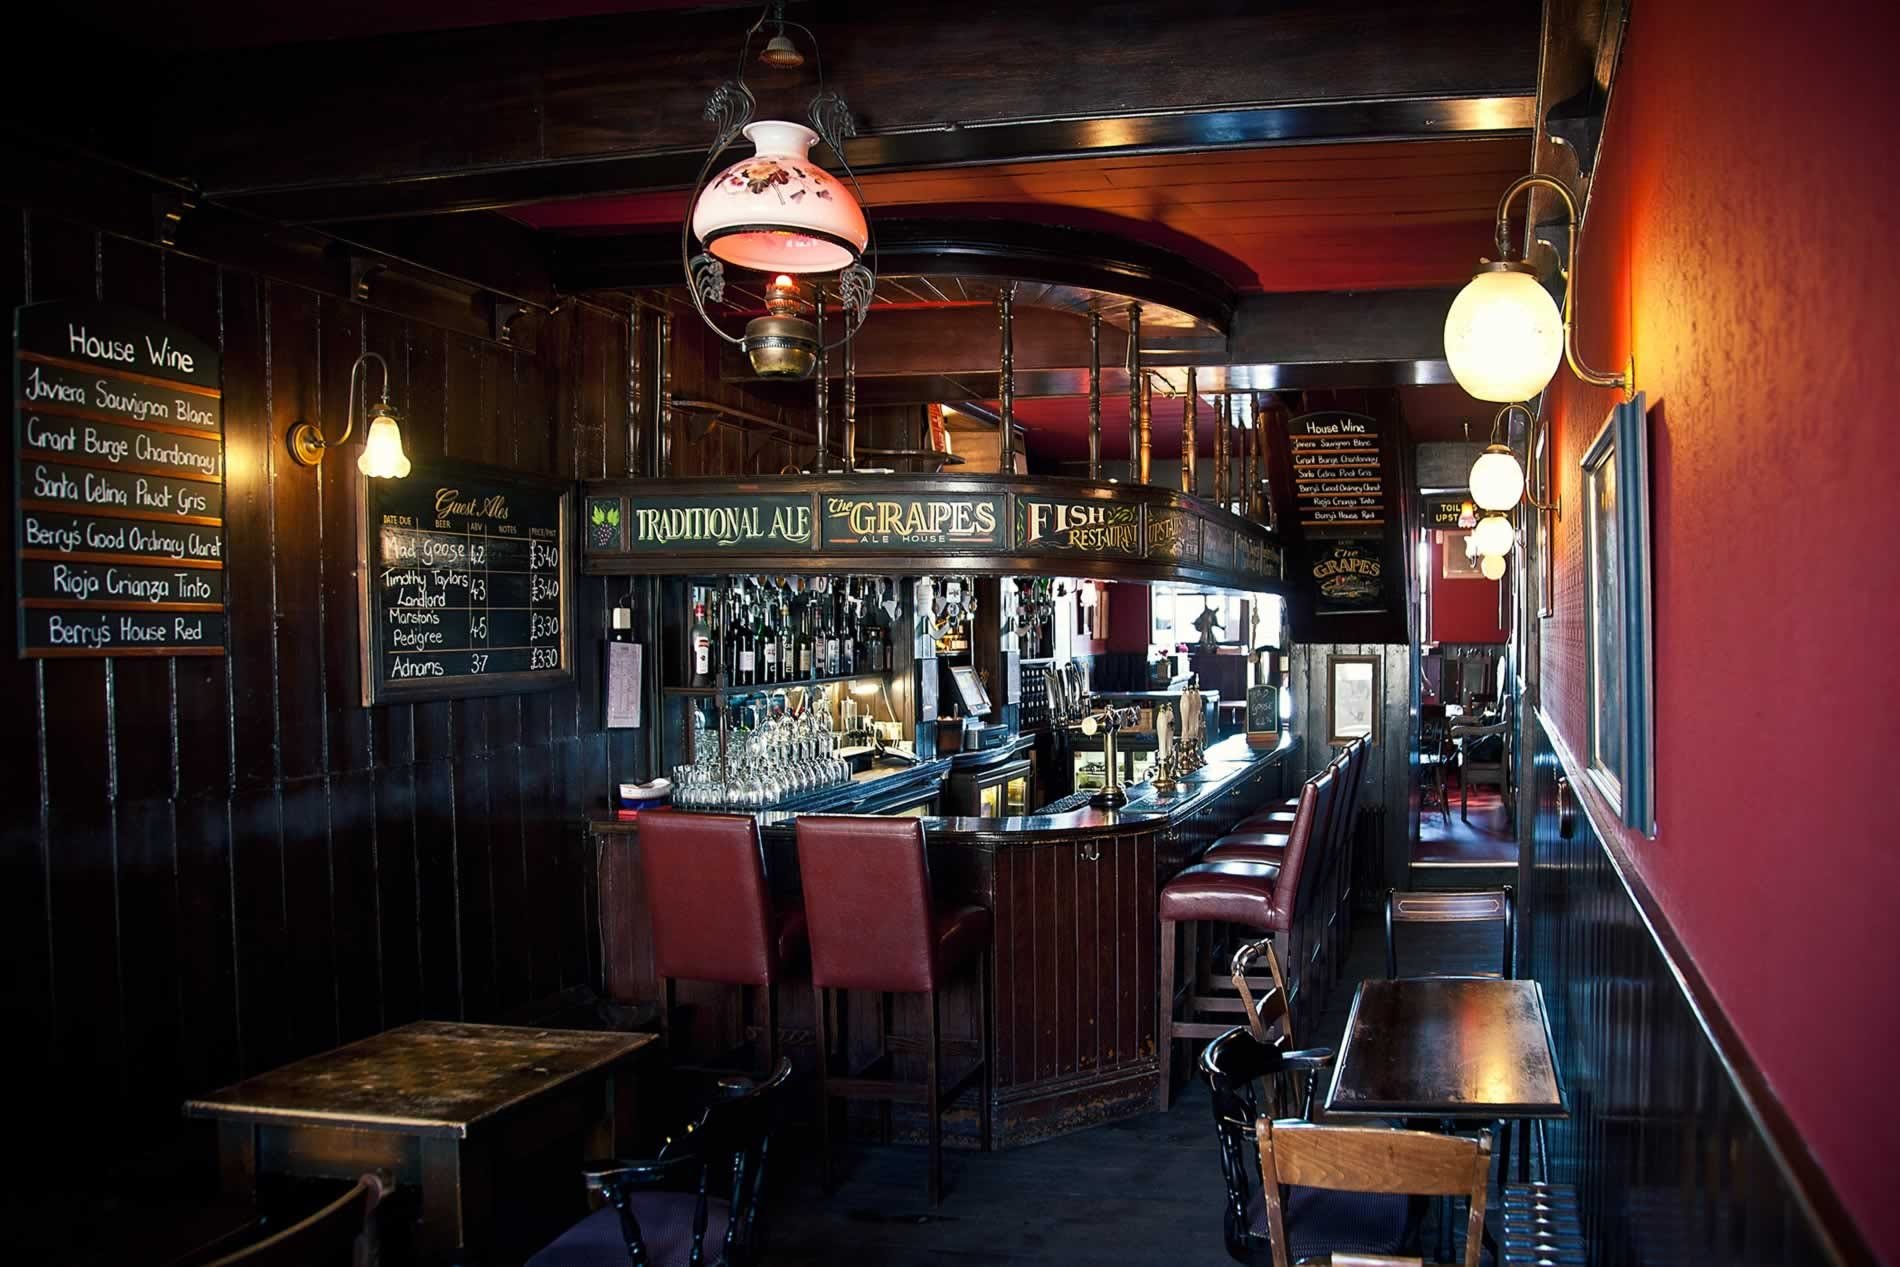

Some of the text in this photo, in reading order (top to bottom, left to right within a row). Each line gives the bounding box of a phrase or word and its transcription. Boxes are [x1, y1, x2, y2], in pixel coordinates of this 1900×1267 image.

[69, 323, 195, 373] House Wine
[25, 367, 214, 425] Javiera Sauvignon Blanc
[1306, 419, 1365, 434] House Wine
[27, 416, 215, 475] Grant Burge Chardonnay
[34, 465, 79, 501] Santa
[85, 473, 128, 507] Celina
[178, 488, 207, 516] Gris
[434, 487, 509, 519] Guest Ales
[828, 497, 997, 536] The GRAPES
[1435, 513, 1480, 522] UPSTS
[1441, 504, 1478, 512] TOILS
[435, 519, 451, 529] BEER
[498, 525, 518, 535] NOTES
[636, 506, 811, 546] TRADITIONAL ALE
[1027, 502, 1105, 544] FISH
[26, 518, 222, 559] Berry's Good Ordinary Claret
[383, 536, 465, 566] Mad Goose
[860, 534, 946, 544] ALE HOUSE
[1068, 524, 1138, 553] RESTAURANT
[1334, 548, 1358, 558] The
[380, 568, 427, 592] Timothy
[1313, 558, 1381, 579] GRAPES
[53, 565, 211, 603] Rioja Crianza Tinto
[397, 587, 446, 608] Landlord
[49, 615, 203, 649] Berry's House Red
[393, 627, 444, 652] Pedigree
[391, 655, 445, 679] Adnams
